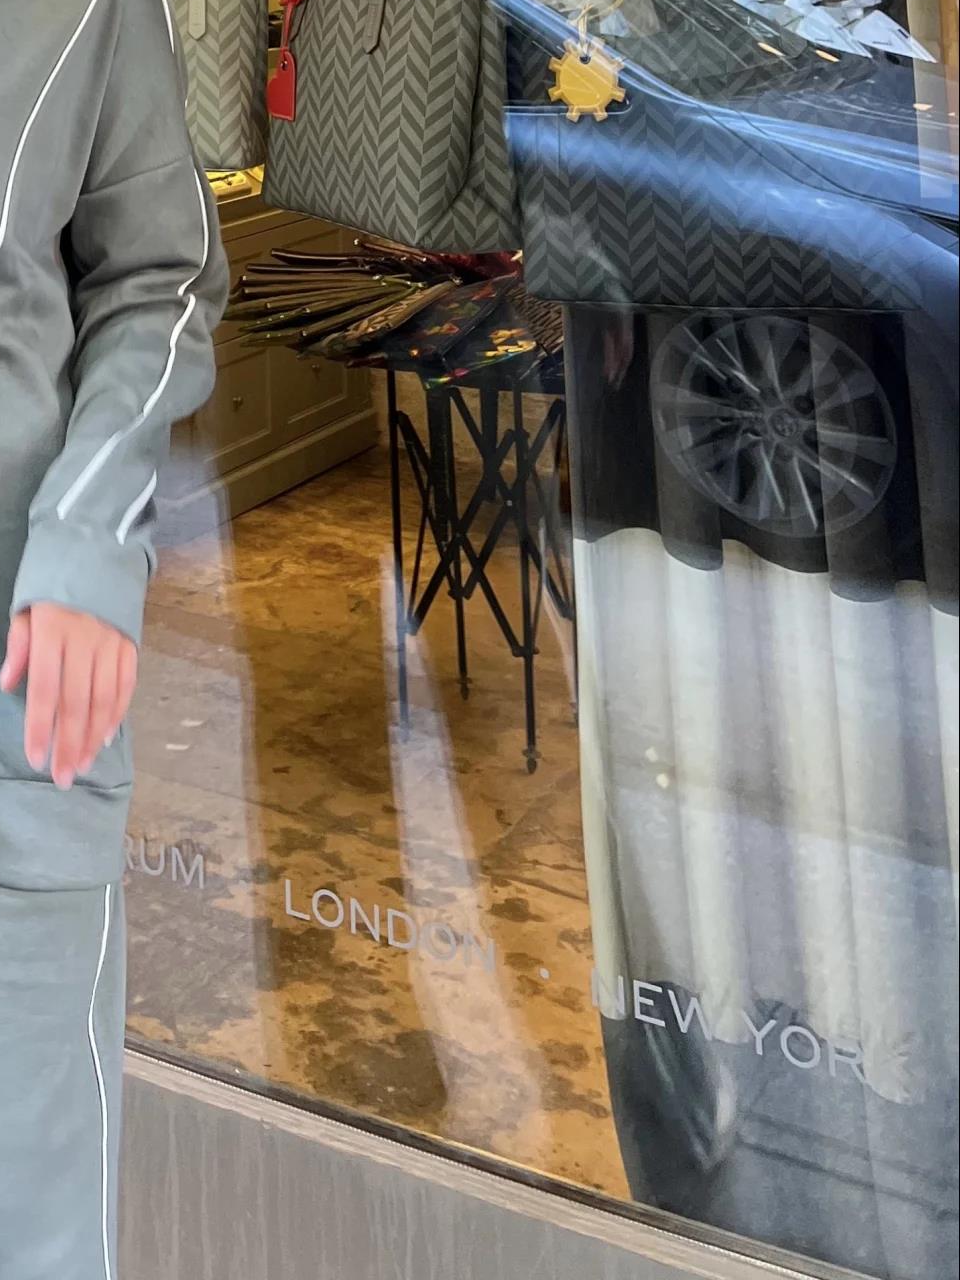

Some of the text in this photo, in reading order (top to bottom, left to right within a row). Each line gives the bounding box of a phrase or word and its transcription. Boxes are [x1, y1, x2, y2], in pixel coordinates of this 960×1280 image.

[284, 878, 496, 974] LONDON
[590, 966, 713, 1041] NEW
[741, 1009, 868, 1084] YOR
